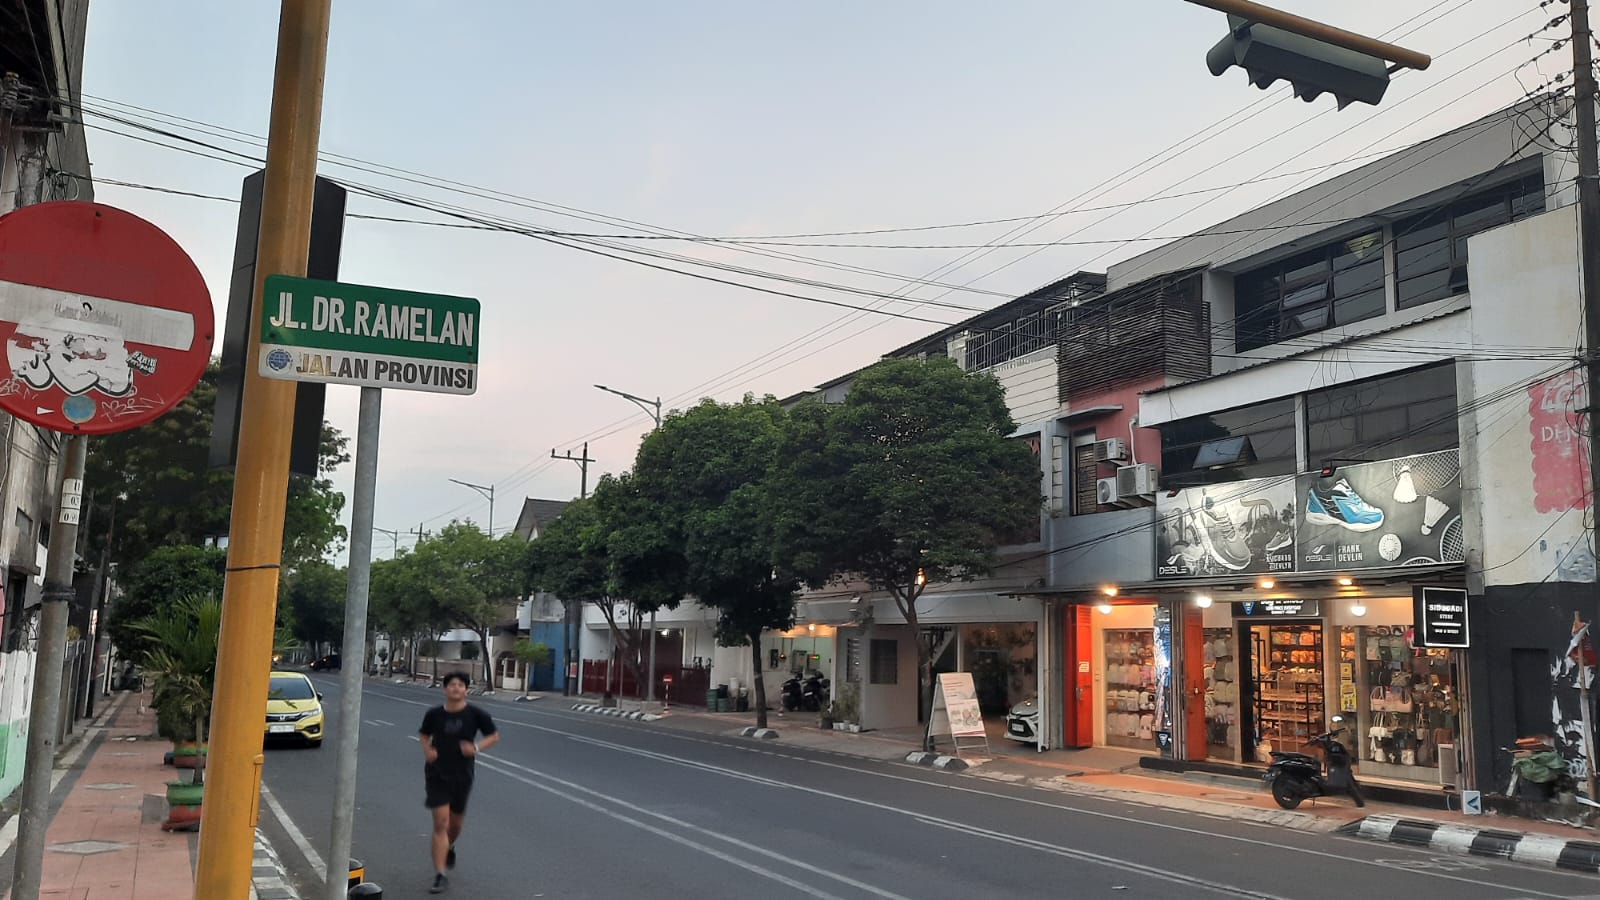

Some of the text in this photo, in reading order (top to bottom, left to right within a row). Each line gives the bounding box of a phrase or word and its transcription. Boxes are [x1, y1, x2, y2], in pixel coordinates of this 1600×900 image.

[269, 291, 475, 347] JL. DR.RAMELAN
[295, 352, 474, 390] JALAN PROVINSI
[1337, 544, 1361, 554] FRANK
[1338, 552, 1363, 562] DEVLIN
[1158, 565, 1188, 575] DESLE
